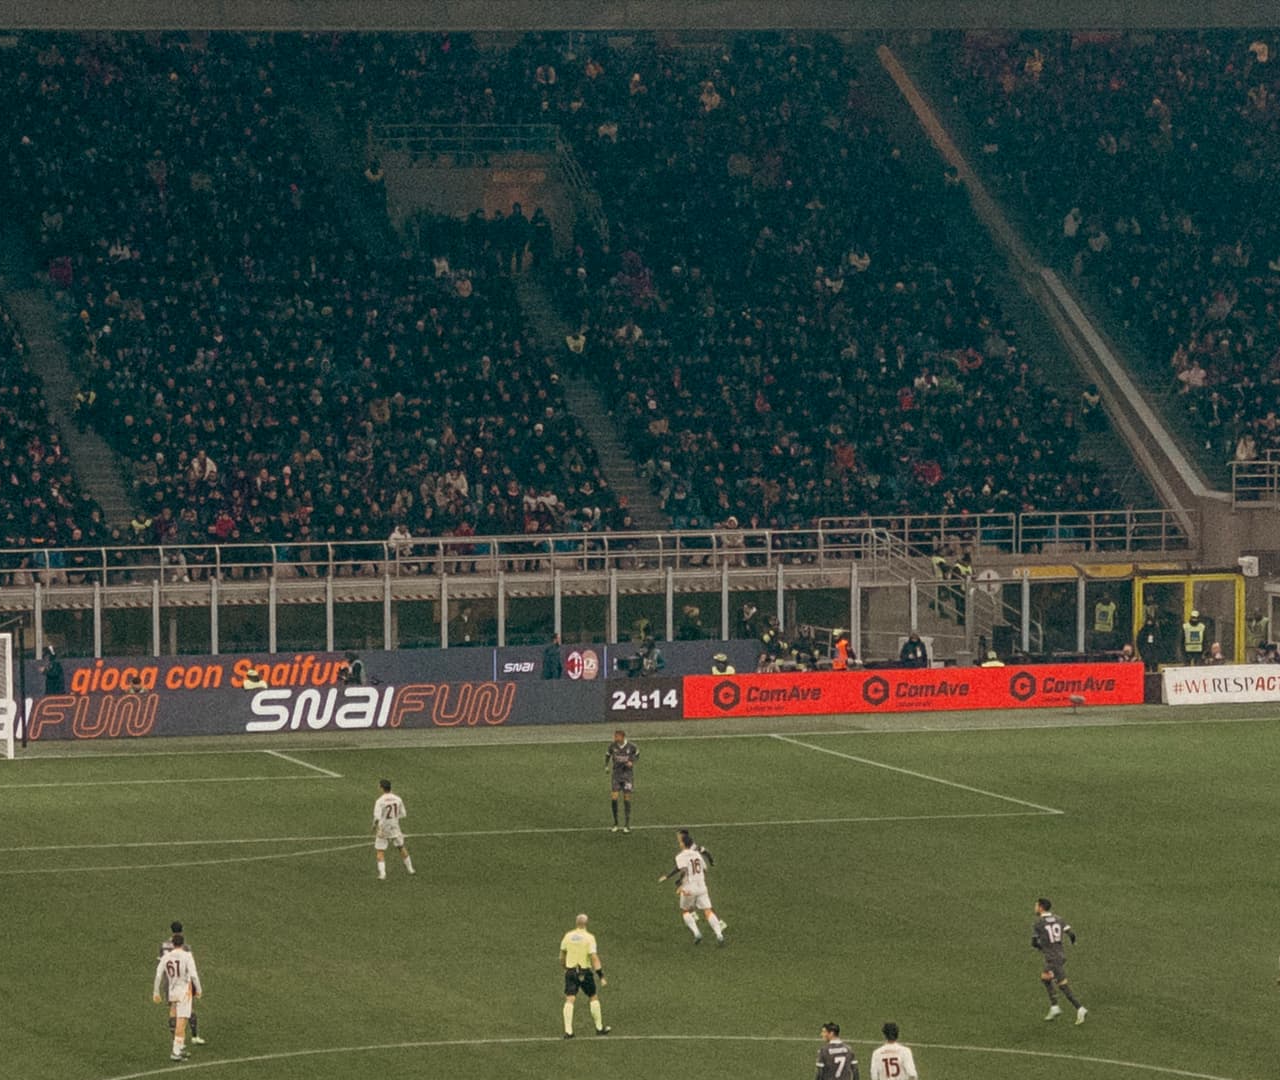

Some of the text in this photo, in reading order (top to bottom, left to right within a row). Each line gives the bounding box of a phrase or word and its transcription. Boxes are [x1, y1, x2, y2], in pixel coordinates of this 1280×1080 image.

[165, 664, 223, 689] con
[1042, 677, 1116, 694] ComAve
[746, 686, 822, 703] ComAve
[895, 681, 969, 698] ComAve
[611, 689, 678, 710] 24:14
[385, 802, 398, 820] 21
[689, 858, 701, 874] 16
[1044, 923, 1061, 943] 19
[834, 1056, 846, 1078] 7
[882, 1057, 901, 1078] 15
